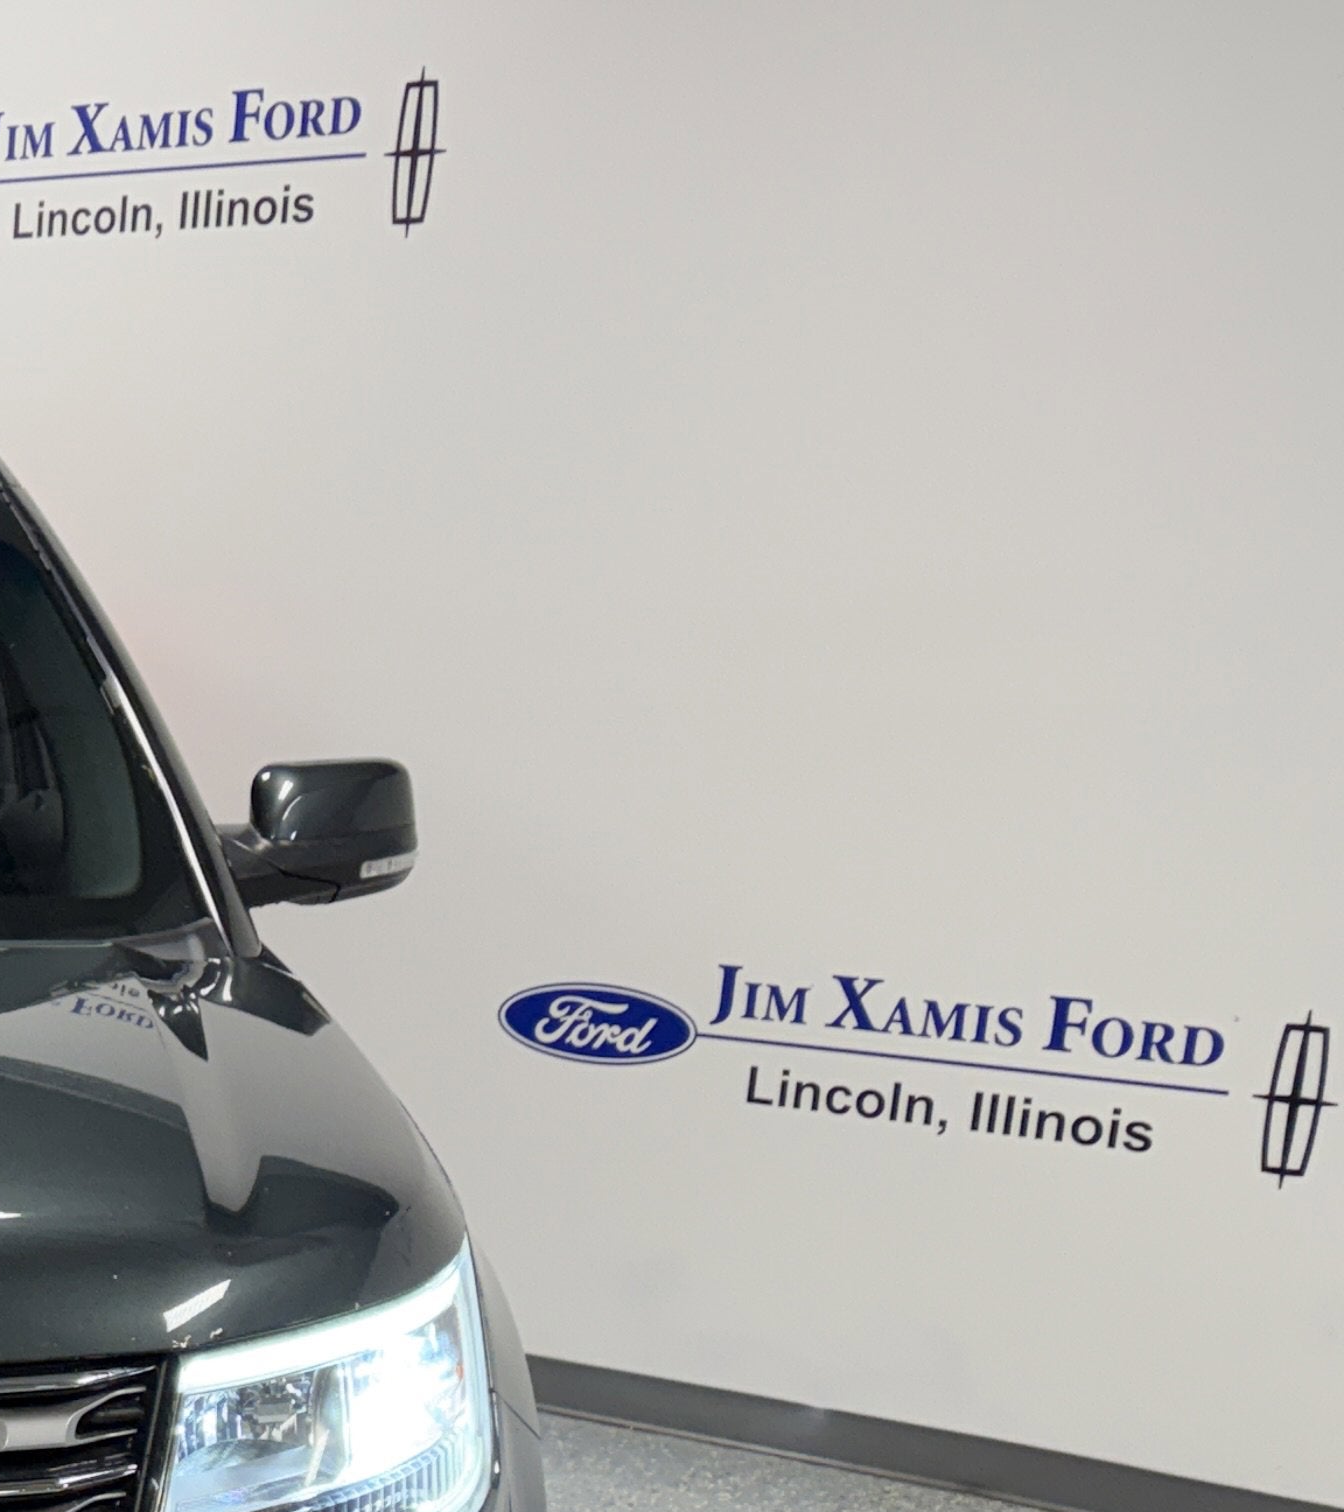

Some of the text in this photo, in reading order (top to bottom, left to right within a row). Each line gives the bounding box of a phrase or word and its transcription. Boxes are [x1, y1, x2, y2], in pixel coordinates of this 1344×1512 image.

[13, 185, 314, 239] Lincoln, Illinois
[533, 997, 654, 1055] Ford
[746, 1066, 1153, 1153] Lincoln, Illinois
